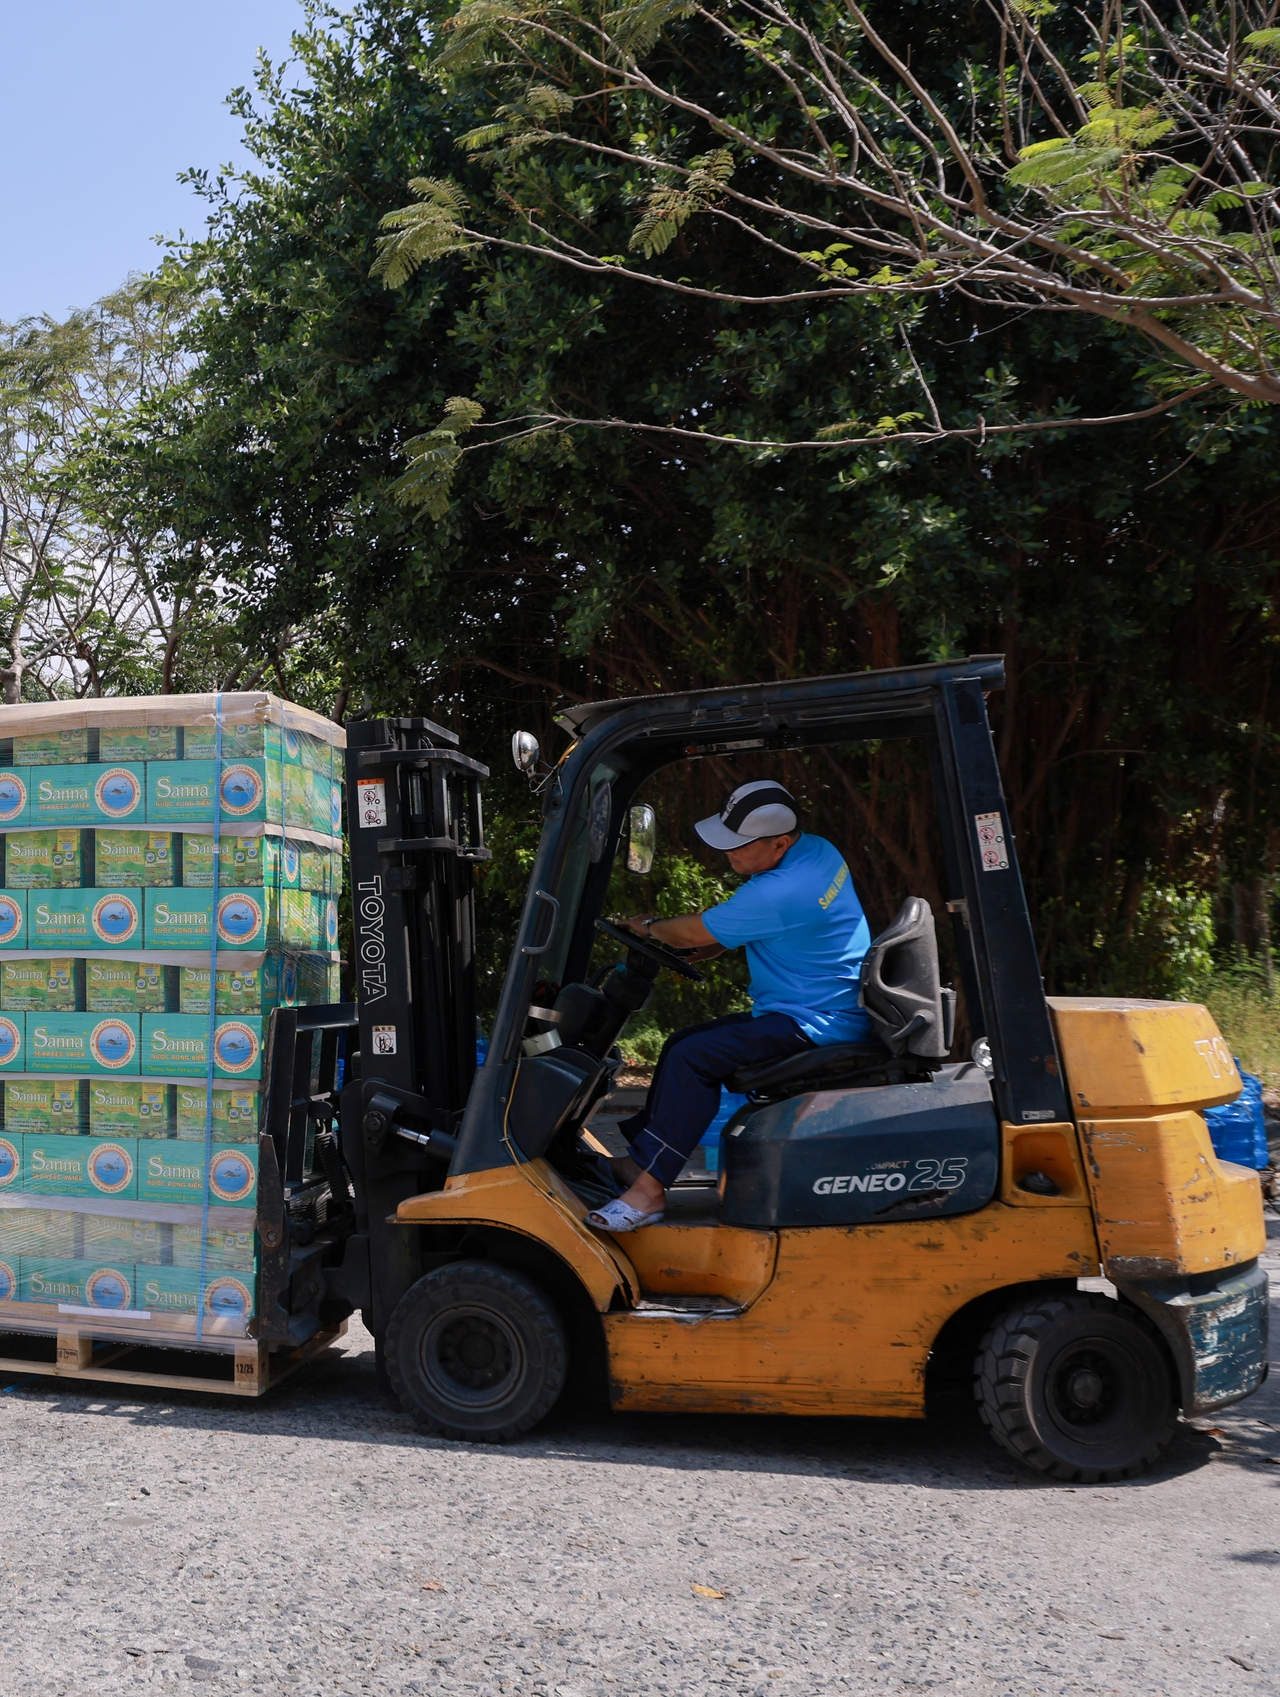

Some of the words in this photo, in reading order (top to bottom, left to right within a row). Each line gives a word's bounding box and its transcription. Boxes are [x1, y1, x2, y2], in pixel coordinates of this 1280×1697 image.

[39, 781, 88, 800] Sanna
[157, 778, 209, 798] Sanna
[10, 842, 48, 857] Sanna
[101, 840, 140, 855] Sanna
[36, 905, 85, 925] Sanna
[155, 904, 207, 924] Sanna
[358, 875, 387, 1005] TOYOTA
[5, 964, 43, 980] Sanna
[91, 965, 131, 980] Sanna
[34, 1028, 83, 1048] Sanna
[153, 1030, 204, 1051] Sanna
[10, 1086, 47, 1102] Sanna
[95, 1090, 134, 1105] Sanna
[33, 1151, 80, 1172] Sanna
[149, 1157, 200, 1179] Sanna
[866, 1161, 910, 1171] OMPACT
[813, 1173, 906, 1195] GENEO
[908, 1157, 968, 1191] 25
[31, 1273, 80, 1295] Sanna
[146, 1283, 197, 1305] Sanna
[236, 1364, 254, 1374] 12/25
